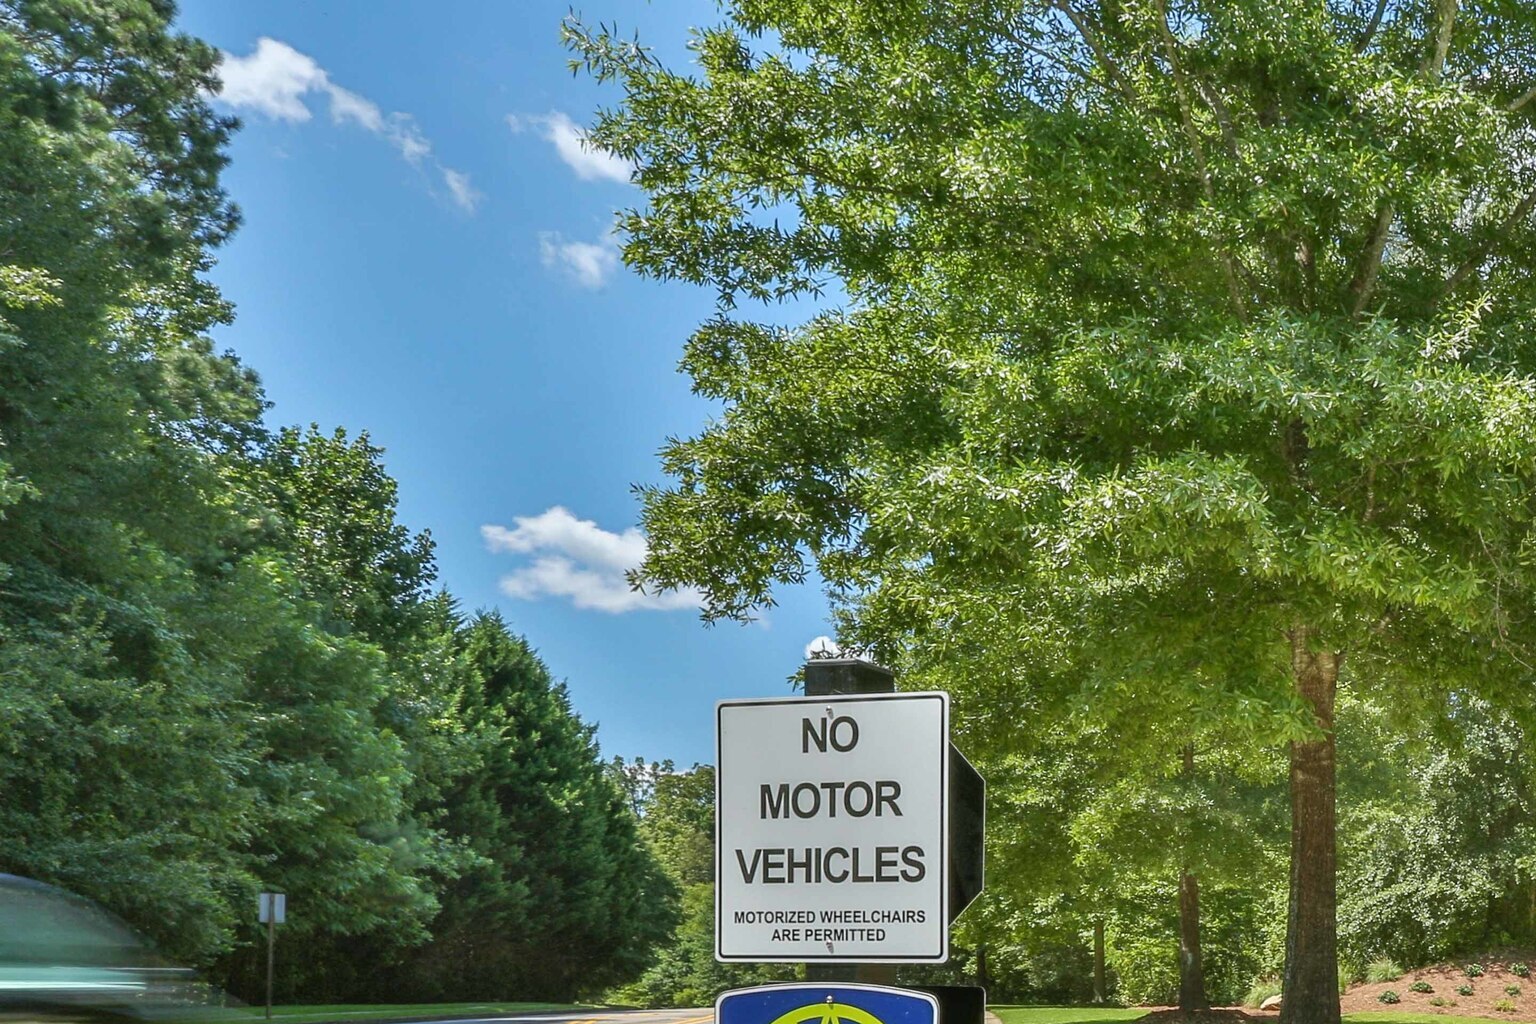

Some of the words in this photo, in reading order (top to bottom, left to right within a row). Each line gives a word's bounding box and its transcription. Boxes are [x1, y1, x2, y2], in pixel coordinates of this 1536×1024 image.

[802, 716, 859, 753] NO
[760, 780, 903, 819] MOTOR
[735, 845, 926, 884] VEHICLES
[734, 911, 816, 924] MOTORIZED
[820, 910, 926, 923] WHEELCHAIRS
[771, 929, 801, 942] ARE
[804, 928, 886, 942] PERMITTED
